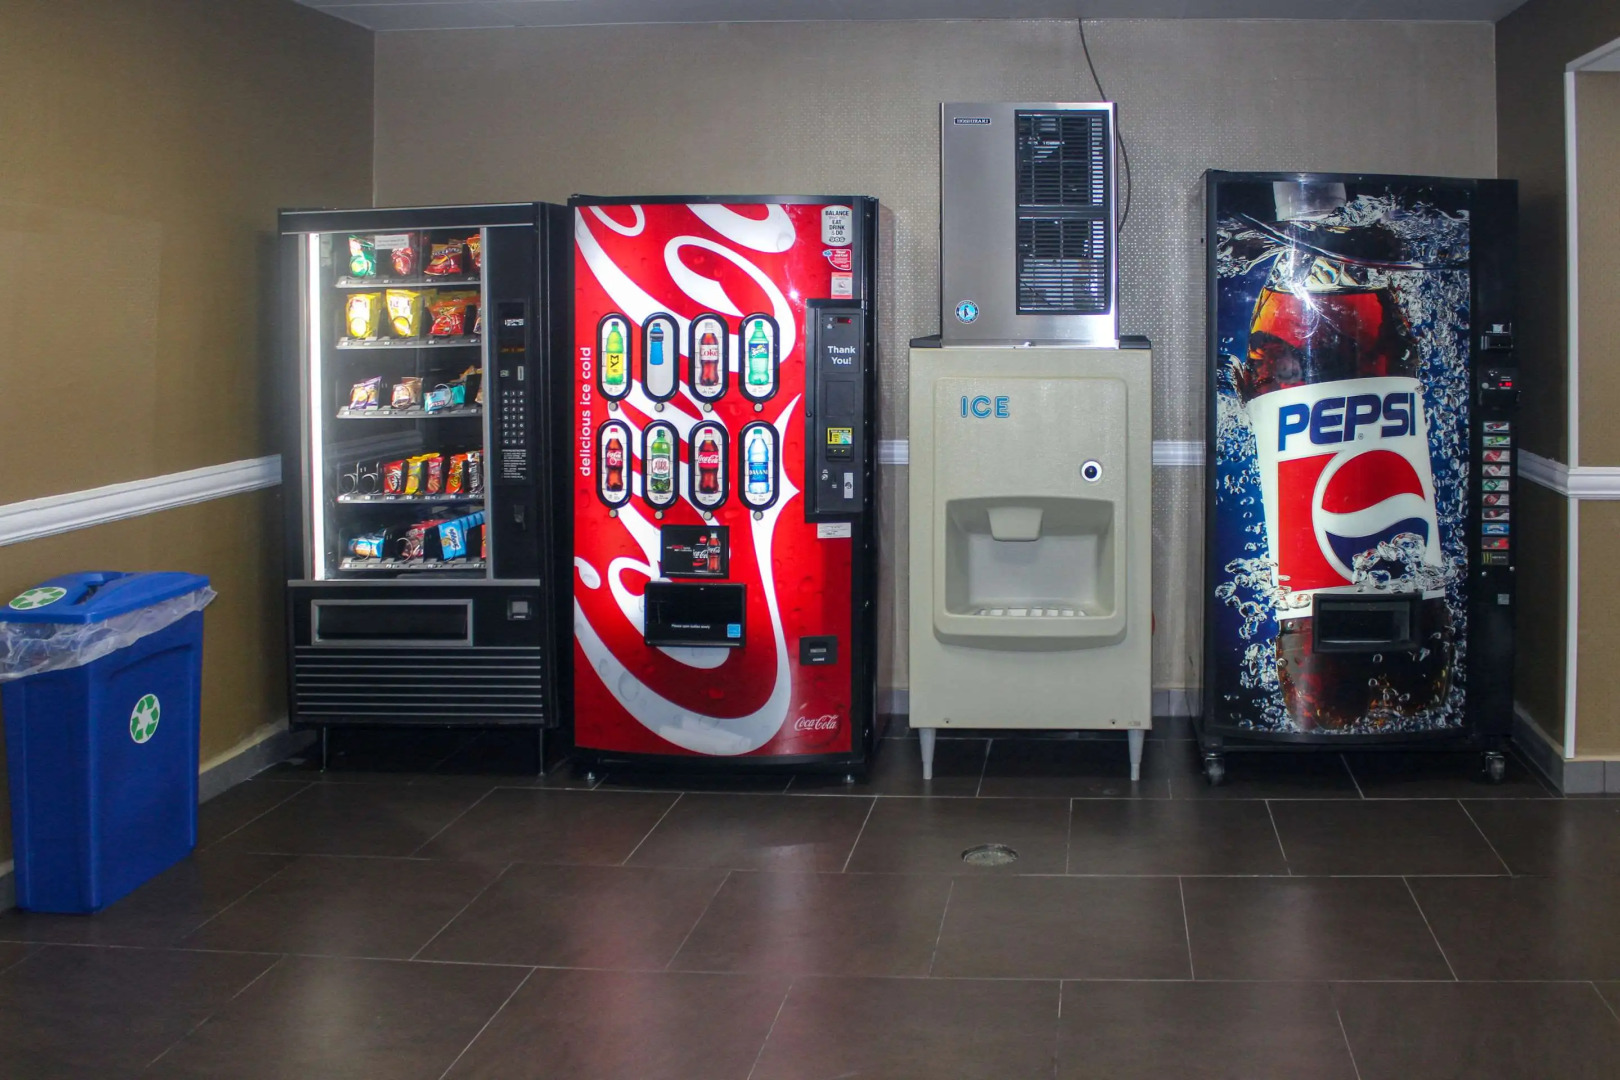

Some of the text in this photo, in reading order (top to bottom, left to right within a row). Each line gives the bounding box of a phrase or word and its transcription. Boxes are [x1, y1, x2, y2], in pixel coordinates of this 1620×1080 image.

[580, 347, 591, 476] delicious ice cold
[961, 395, 1010, 418] ICE
[1278, 392, 1416, 452] PEPSI
[794, 714, 838, 732] Coca-Cola
